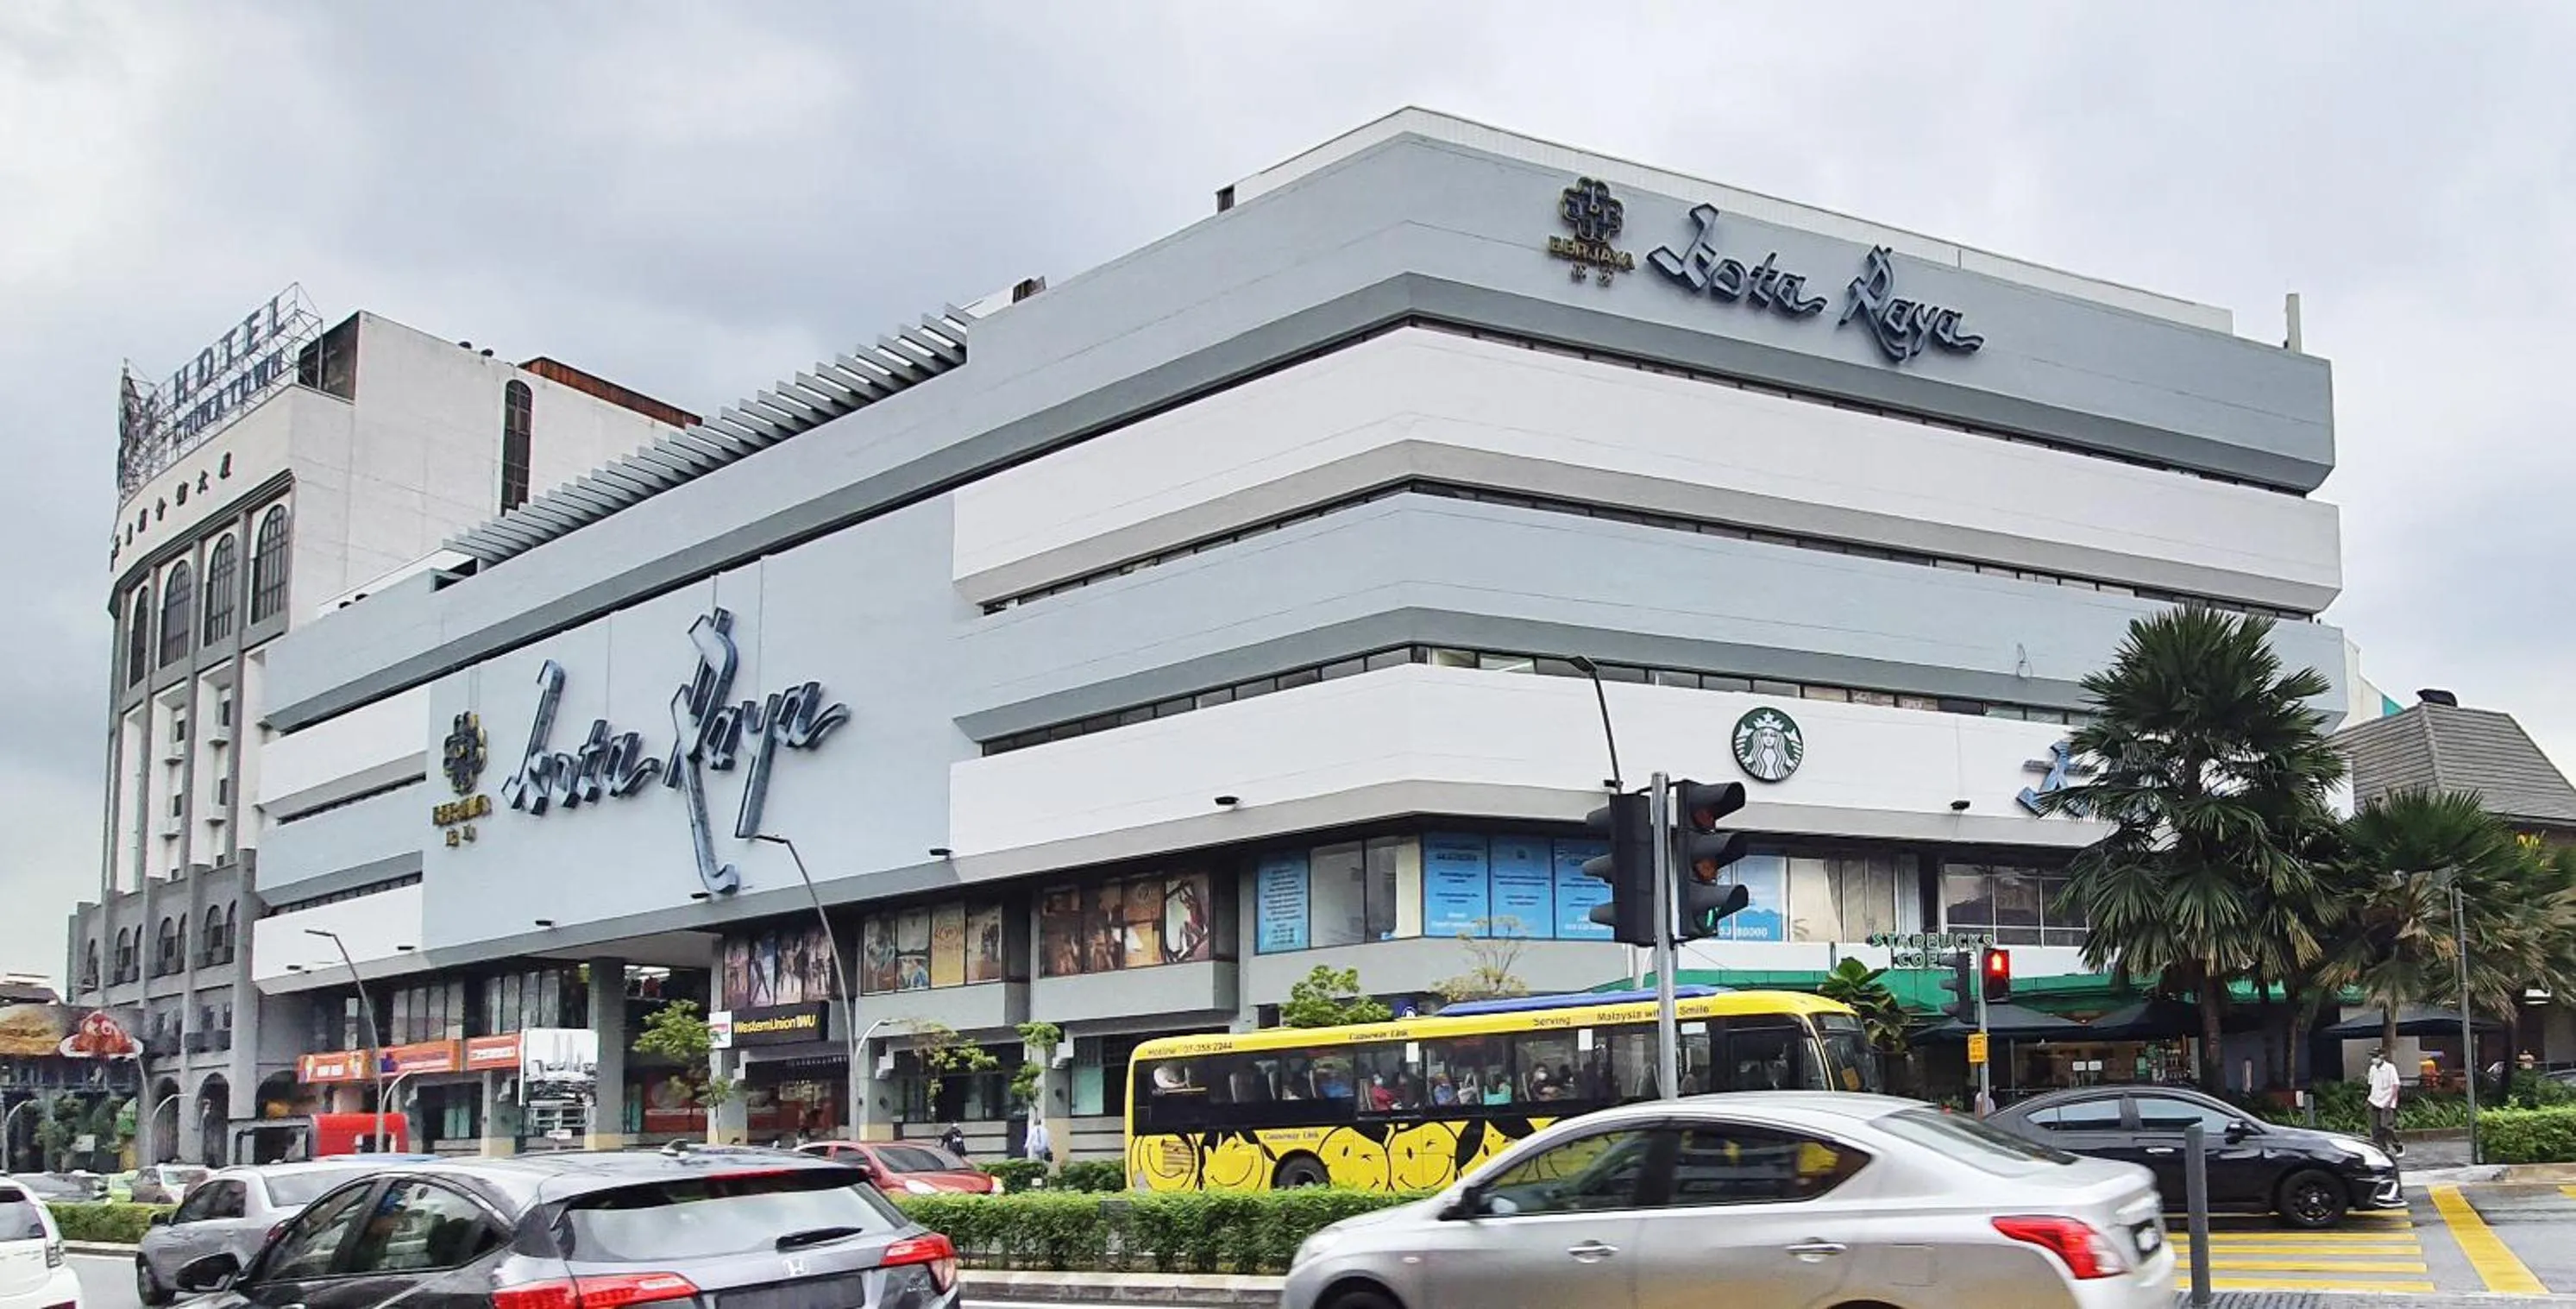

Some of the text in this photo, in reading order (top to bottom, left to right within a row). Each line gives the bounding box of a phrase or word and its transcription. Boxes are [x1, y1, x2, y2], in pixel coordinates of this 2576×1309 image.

[174, 295, 286, 410] HOTEL
[1836, 243, 1985, 363] Raya
[662, 606, 851, 895] Raya
[1870, 932, 1994, 949] STARBUCKS
[1533, 1016, 1571, 1027] Serving
[1597, 1010, 1641, 1023] Malaysia
[1679, 1004, 1710, 1016] Smile
